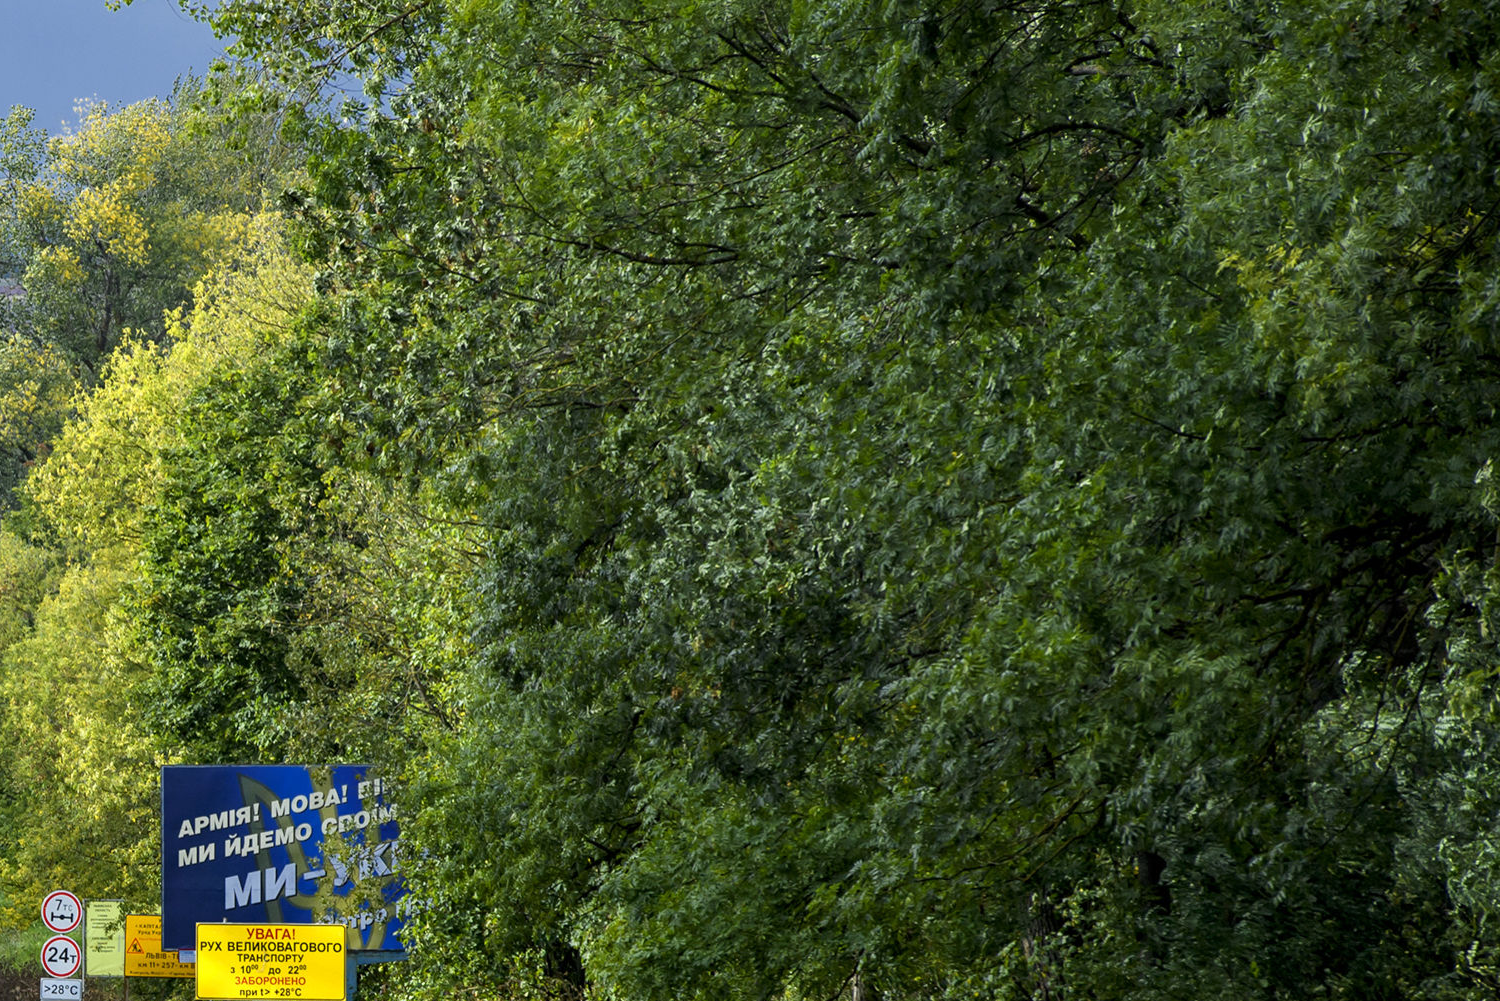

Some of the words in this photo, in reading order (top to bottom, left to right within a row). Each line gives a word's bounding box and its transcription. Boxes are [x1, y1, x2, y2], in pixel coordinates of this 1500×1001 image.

[178, 803, 260, 838] АРМІЯ!
[271, 785, 348, 819] МОВА!
[178, 843, 215, 867] МИ
[224, 823, 312, 857] ЙДЕМО
[246, 928, 296, 940] УВАГА!
[200, 941, 222, 951] РУХ
[227, 941, 342, 952] ВЕЛИКОВАГОВОГО
[237, 954, 304, 962] ТРАНСПОРТУ
[268, 967, 281, 975] до
[235, 976, 306, 985] ЗАБОРОНЕНО
[239, 989, 257, 997] при
